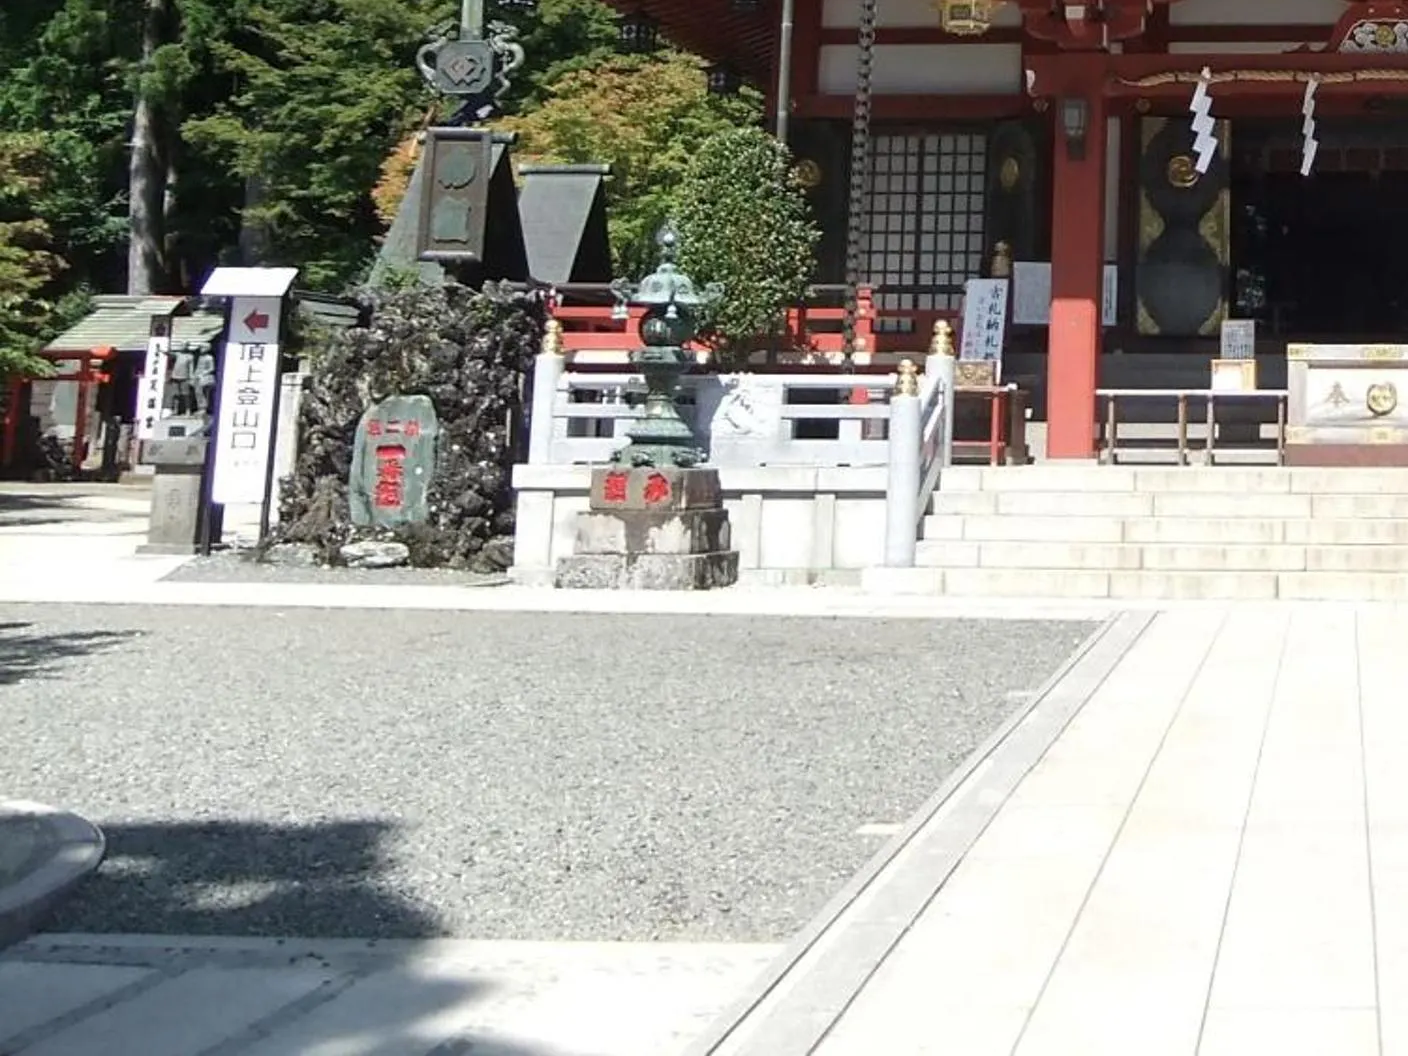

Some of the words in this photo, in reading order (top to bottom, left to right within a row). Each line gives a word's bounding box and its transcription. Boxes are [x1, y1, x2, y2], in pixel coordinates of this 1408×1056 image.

[230, 343, 265, 449] 頂上登山口
